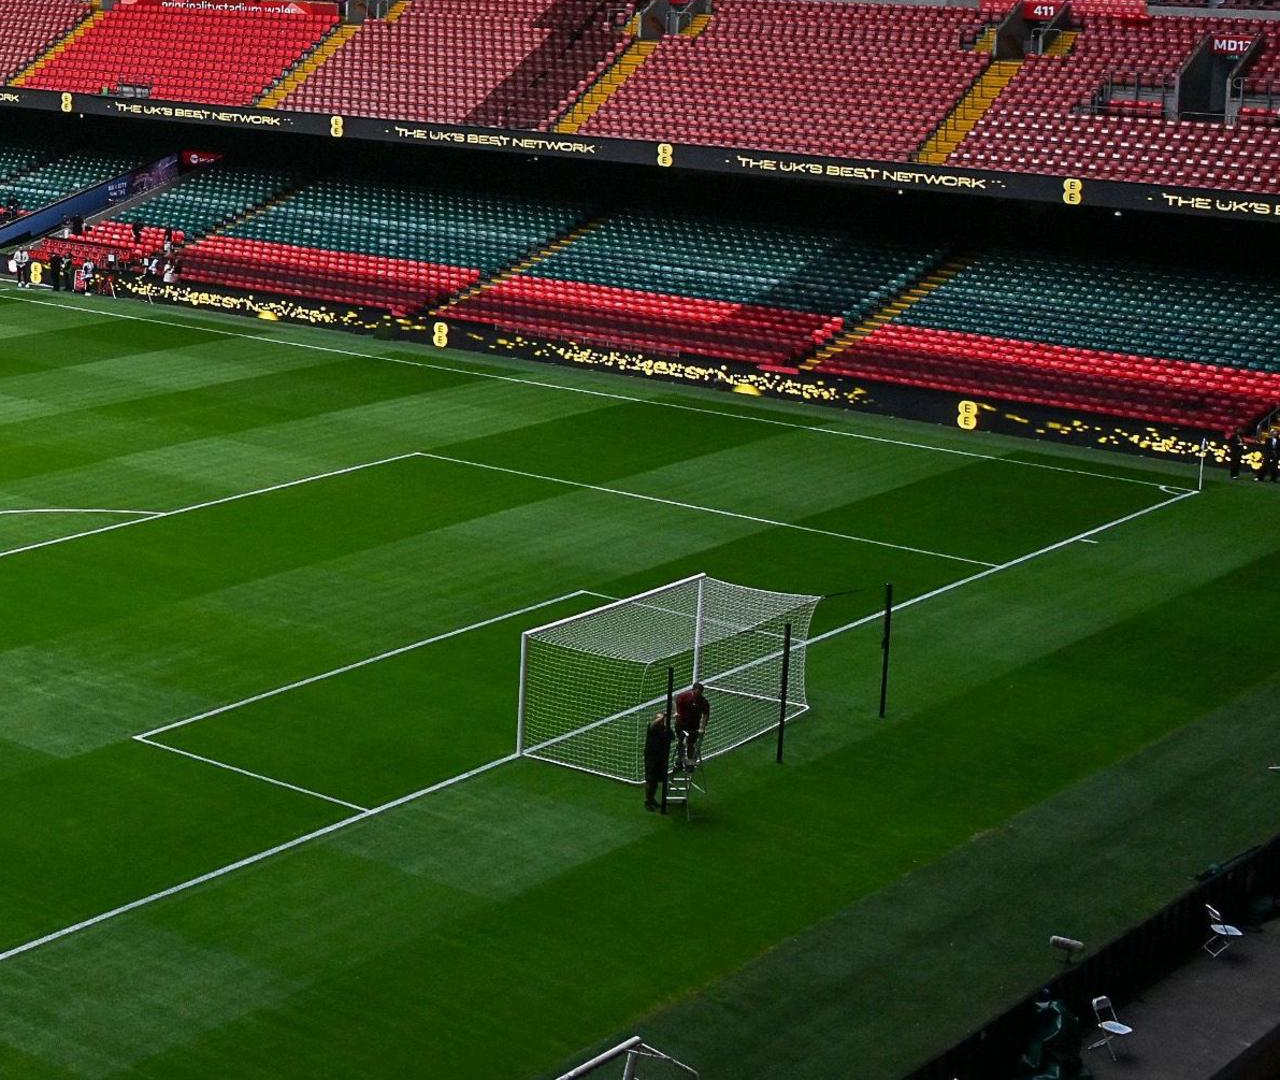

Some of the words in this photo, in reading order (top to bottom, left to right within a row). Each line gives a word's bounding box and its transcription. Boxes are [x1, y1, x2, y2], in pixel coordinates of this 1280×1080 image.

[1034, 5, 1054, 17] 411
[115, 102, 142, 113] THE
[175, 109, 210, 119] BEST
[212, 112, 280, 125] NETWORK
[396, 127, 426, 138] THE
[467, 134, 509, 146] BEST
[512, 139, 595, 153] NETWORK
[737, 156, 776, 170] THE
[826, 166, 880, 179] BEST
[882, 171, 986, 188] NETWORK
[1163, 193, 1211, 209] THE
